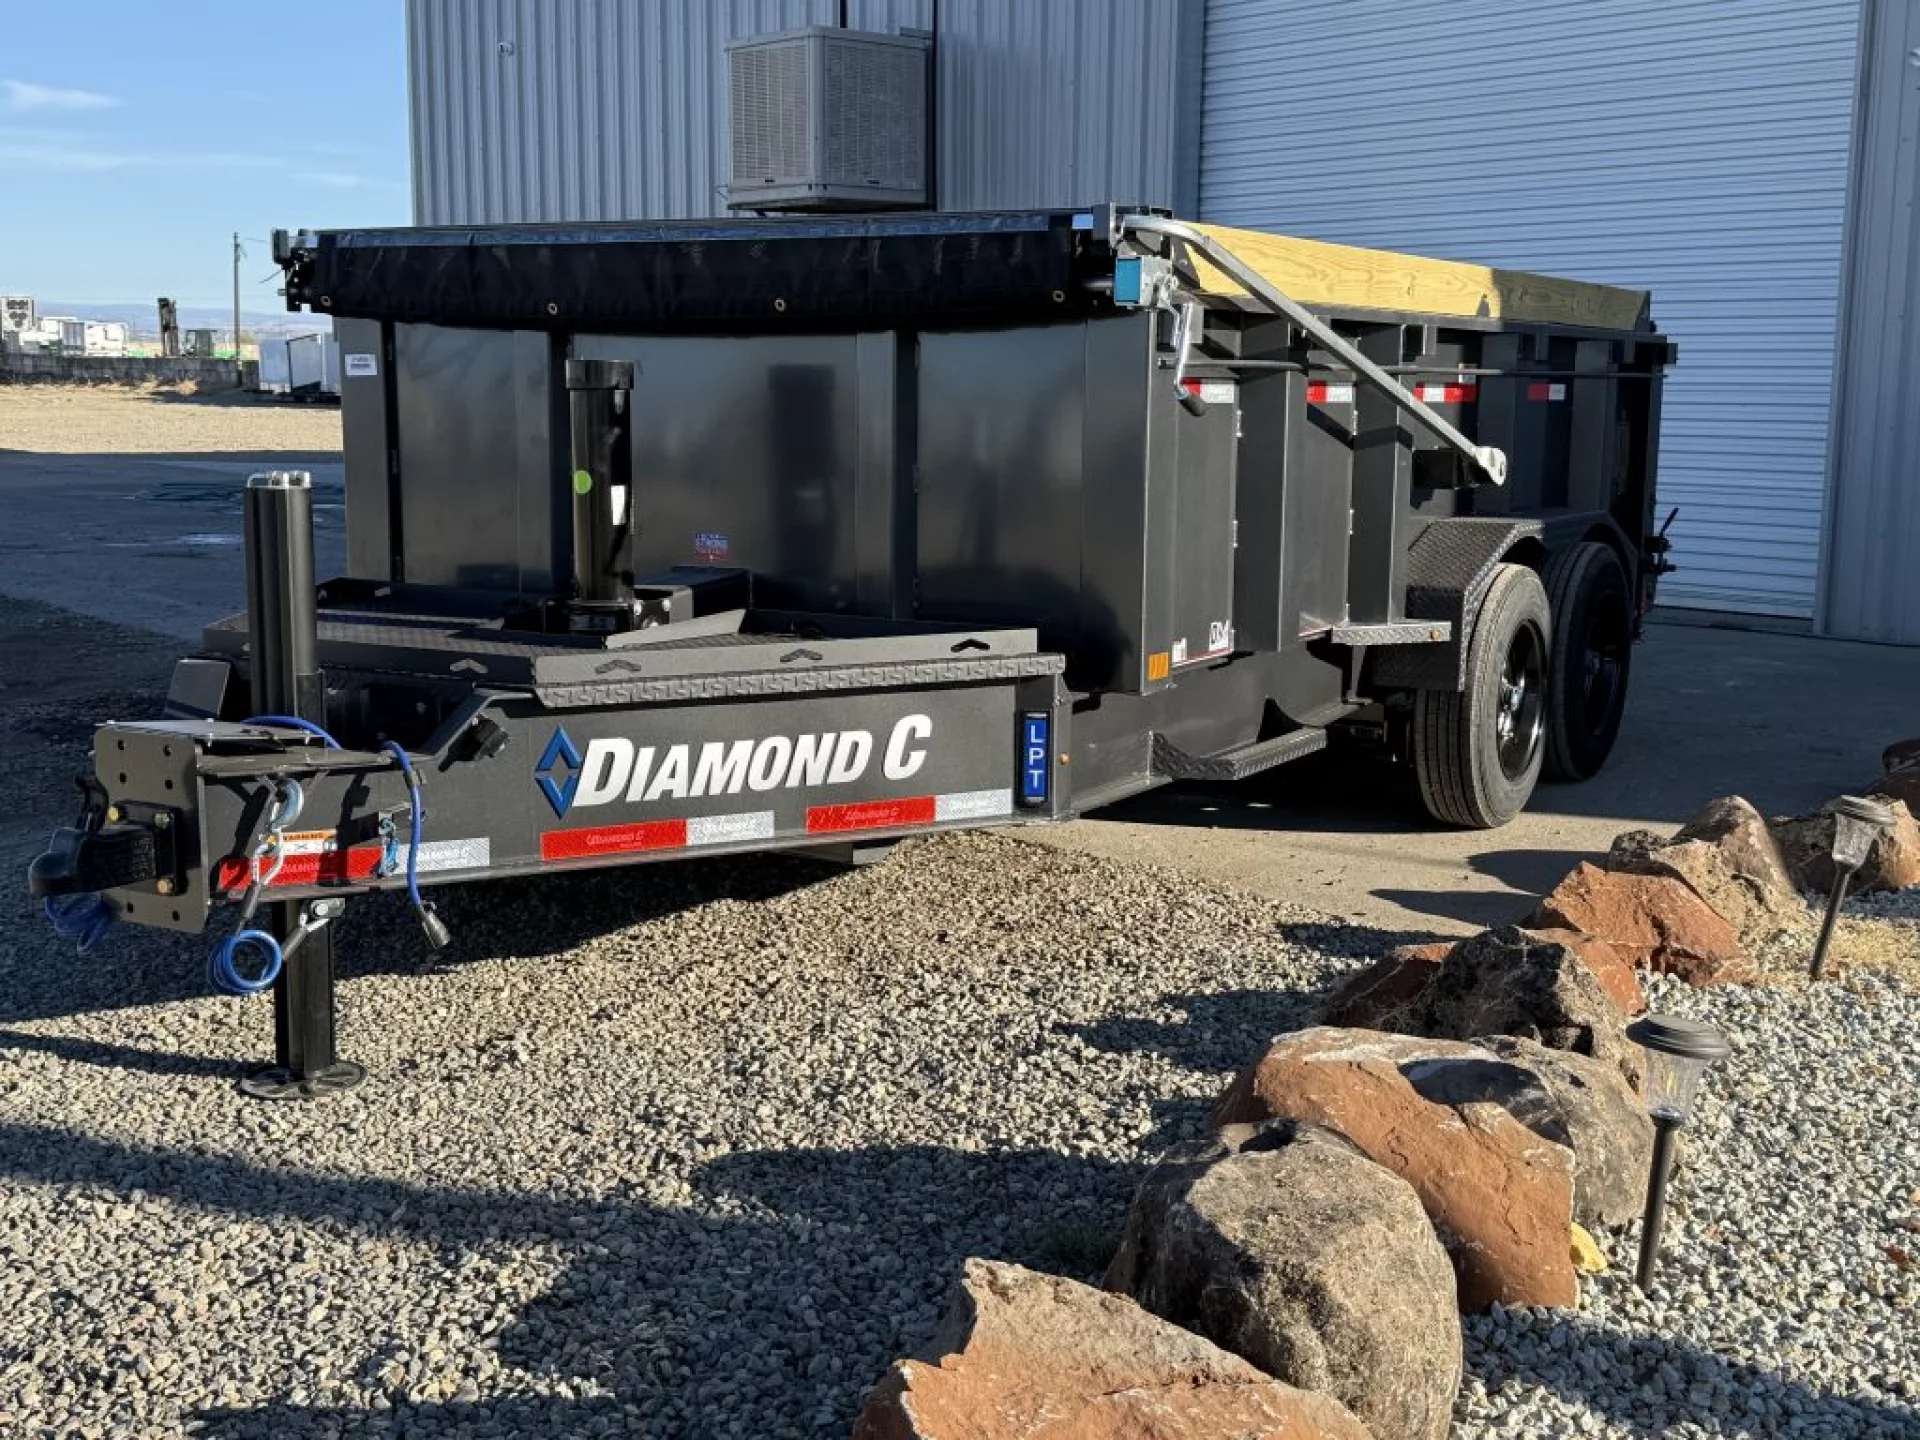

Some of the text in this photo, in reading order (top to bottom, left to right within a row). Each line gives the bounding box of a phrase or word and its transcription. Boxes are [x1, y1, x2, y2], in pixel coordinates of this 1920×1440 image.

[571, 714, 933, 807] DIAMOND C
[1028, 725, 1045, 788] LPT
